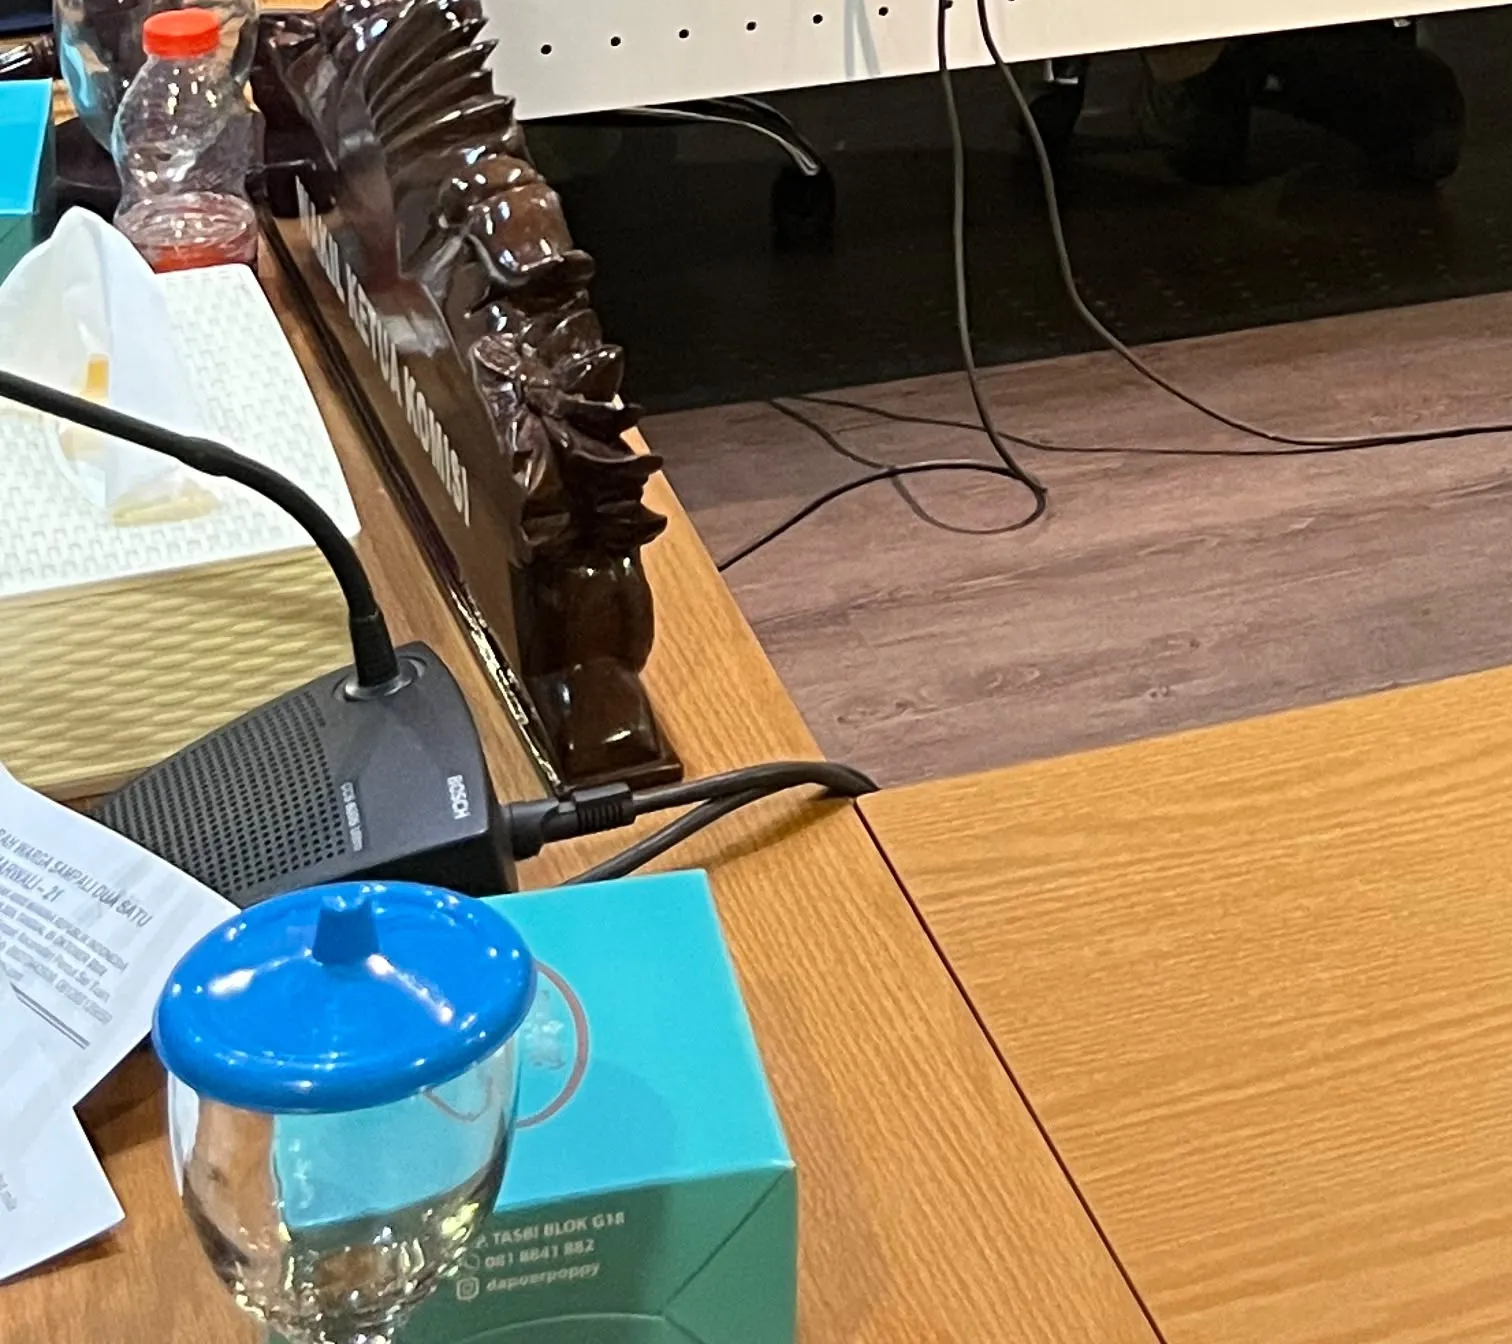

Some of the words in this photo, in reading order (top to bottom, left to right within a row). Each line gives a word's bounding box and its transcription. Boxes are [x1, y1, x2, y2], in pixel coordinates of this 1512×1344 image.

[346, 263, 403, 408] KETUA
[403, 365, 471, 527] KOMISI
[447, 774, 471, 820] BOSCH
[116, 900, 153, 927] SATU
[543, 1216, 588, 1237] BLOK
